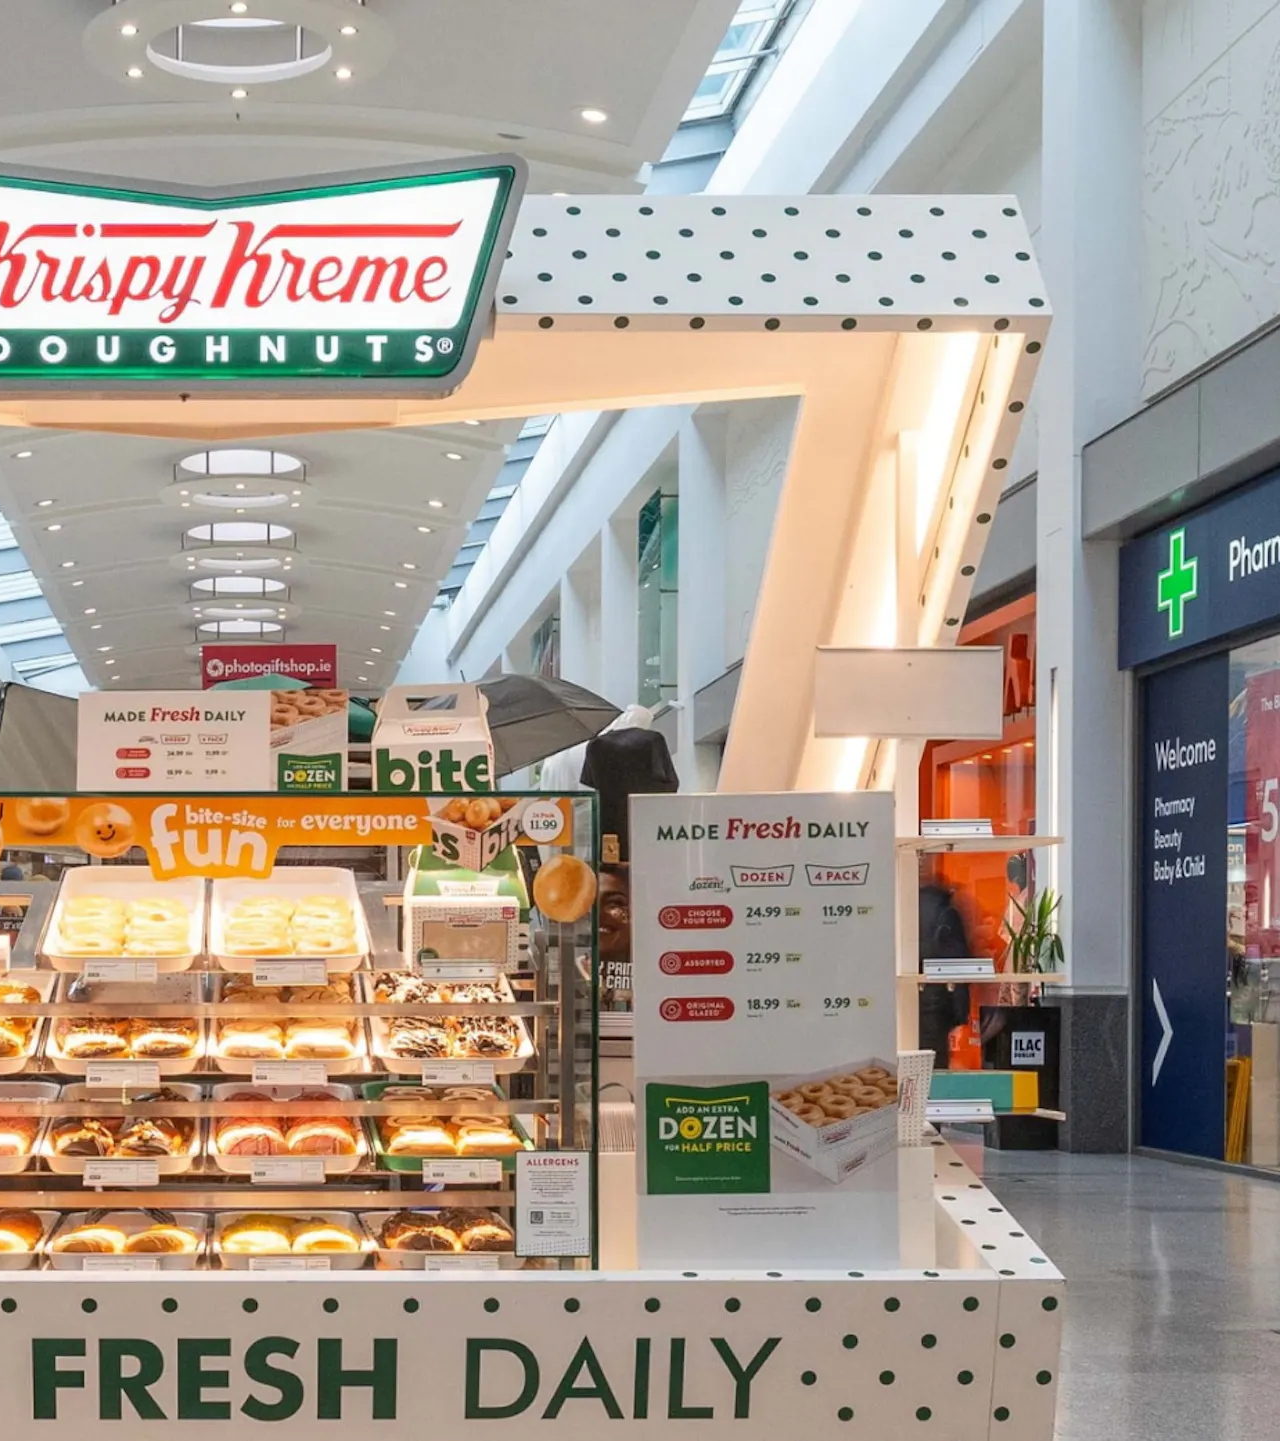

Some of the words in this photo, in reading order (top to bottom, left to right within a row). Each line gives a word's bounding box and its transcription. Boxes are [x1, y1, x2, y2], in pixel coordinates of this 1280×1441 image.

[210, 218, 464, 309] Kreme
[225, 659, 332, 676] photogiftshop.ie
[104, 710, 146, 722] MADE
[150, 706, 200, 722] Fresh
[204, 710, 246, 722] DAILY
[1154, 737, 1216, 771] Welcome
[283, 770, 336, 782] DOZEN
[1154, 796, 1195, 818] Pharmacy
[185, 805, 268, 829] bite-size
[277, 816, 297, 828] for
[301, 813, 418, 837] everyone
[530, 820, 557, 830] 11.99
[657, 825, 719, 840] MADE
[726, 816, 801, 840] Fresh
[808, 822, 869, 839] DAILY
[150, 803, 269, 872] fun
[1154, 829, 1182, 851] Beauty
[740, 872, 784, 882] DOZEN
[815, 873, 821, 881] 4
[826, 871, 860, 881] PACK
[1154, 862, 1174, 885] Baby
[1175, 860, 1183, 878] &
[1183, 855, 1205, 877] Child
[746, 907, 781, 918] 24.99
[823, 905, 852, 917] 11.99
[684, 959, 725, 967] ASSORTED
[746, 953, 780, 964] 22.99
[747, 999, 780, 1010] 18.99
[824, 998, 850, 1009] 9.99
[1014, 1039, 1041, 1051] ILAC
[676, 1106, 694, 1114] ADD
[697, 1106, 710, 1114] AN
[659, 1116, 757, 1140] DOZEN
[682, 1142, 712, 1153] HALF
[716, 1142, 751, 1152] PRICE
[527, 1158, 579, 1166] ALLERGENS
[33, 1336, 398, 1420] FRESH
[463, 1336, 783, 1420] DAILY
